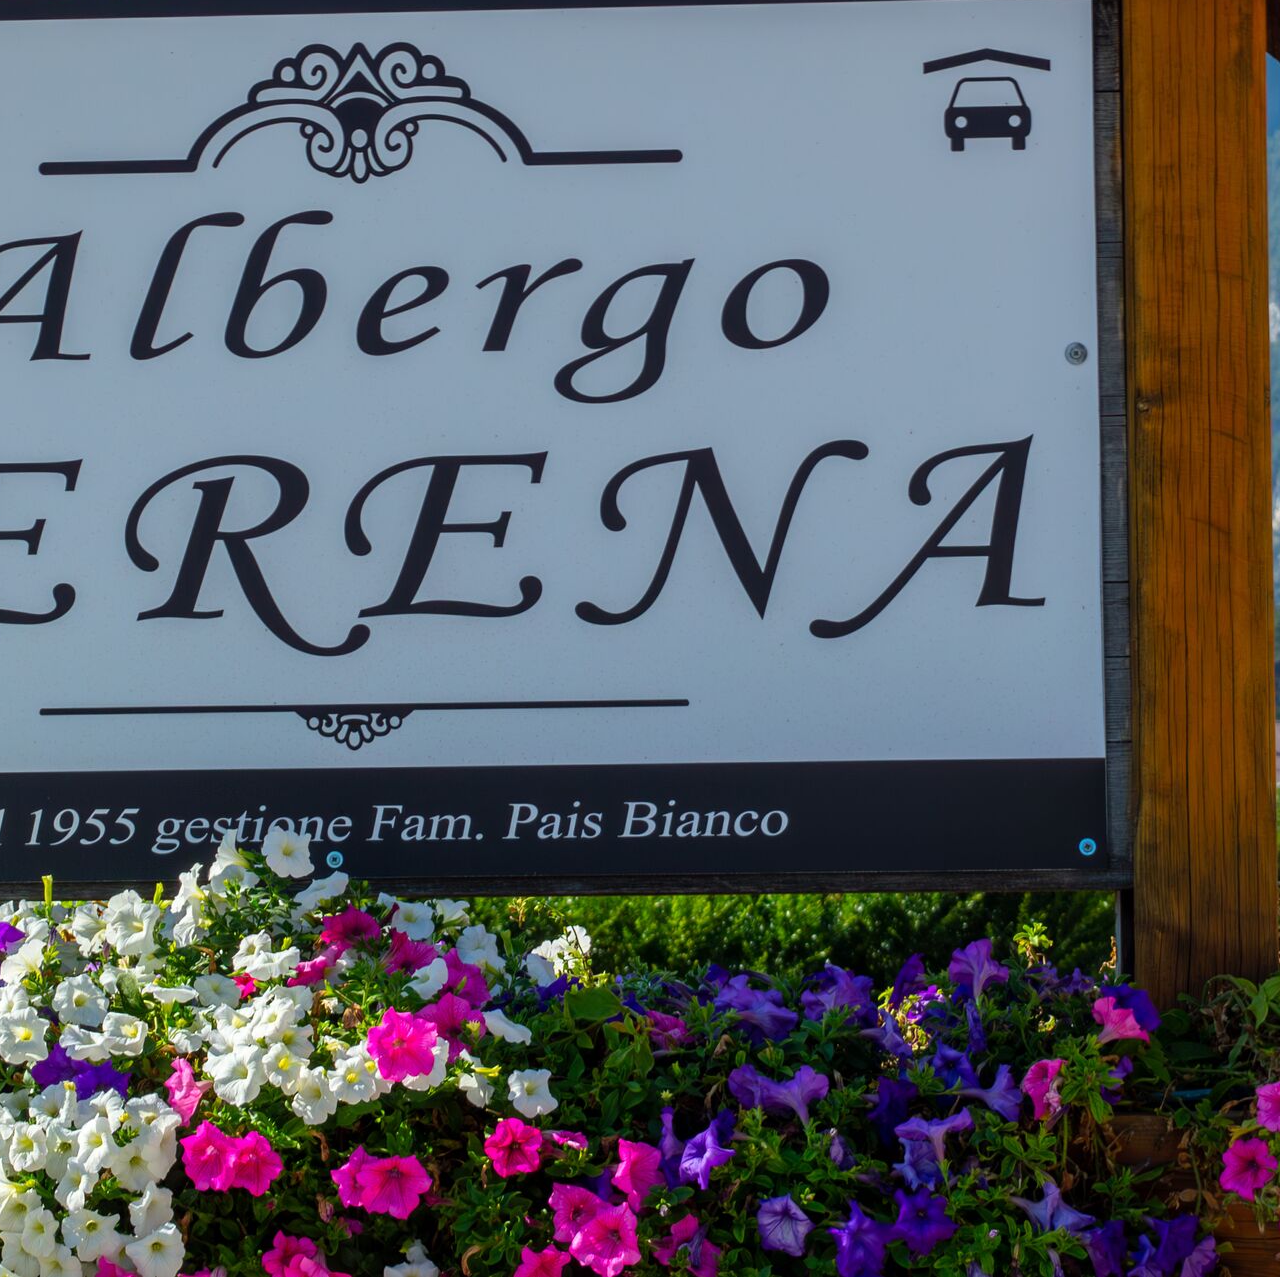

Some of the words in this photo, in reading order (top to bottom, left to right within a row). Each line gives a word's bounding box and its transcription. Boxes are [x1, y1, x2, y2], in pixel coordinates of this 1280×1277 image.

[25, 808, 140, 846] 1955
[151, 805, 353, 855] gestione
[367, 805, 484, 841] Fam.
[503, 801, 603, 840] Pais
[618, 800, 789, 838] Bianco
